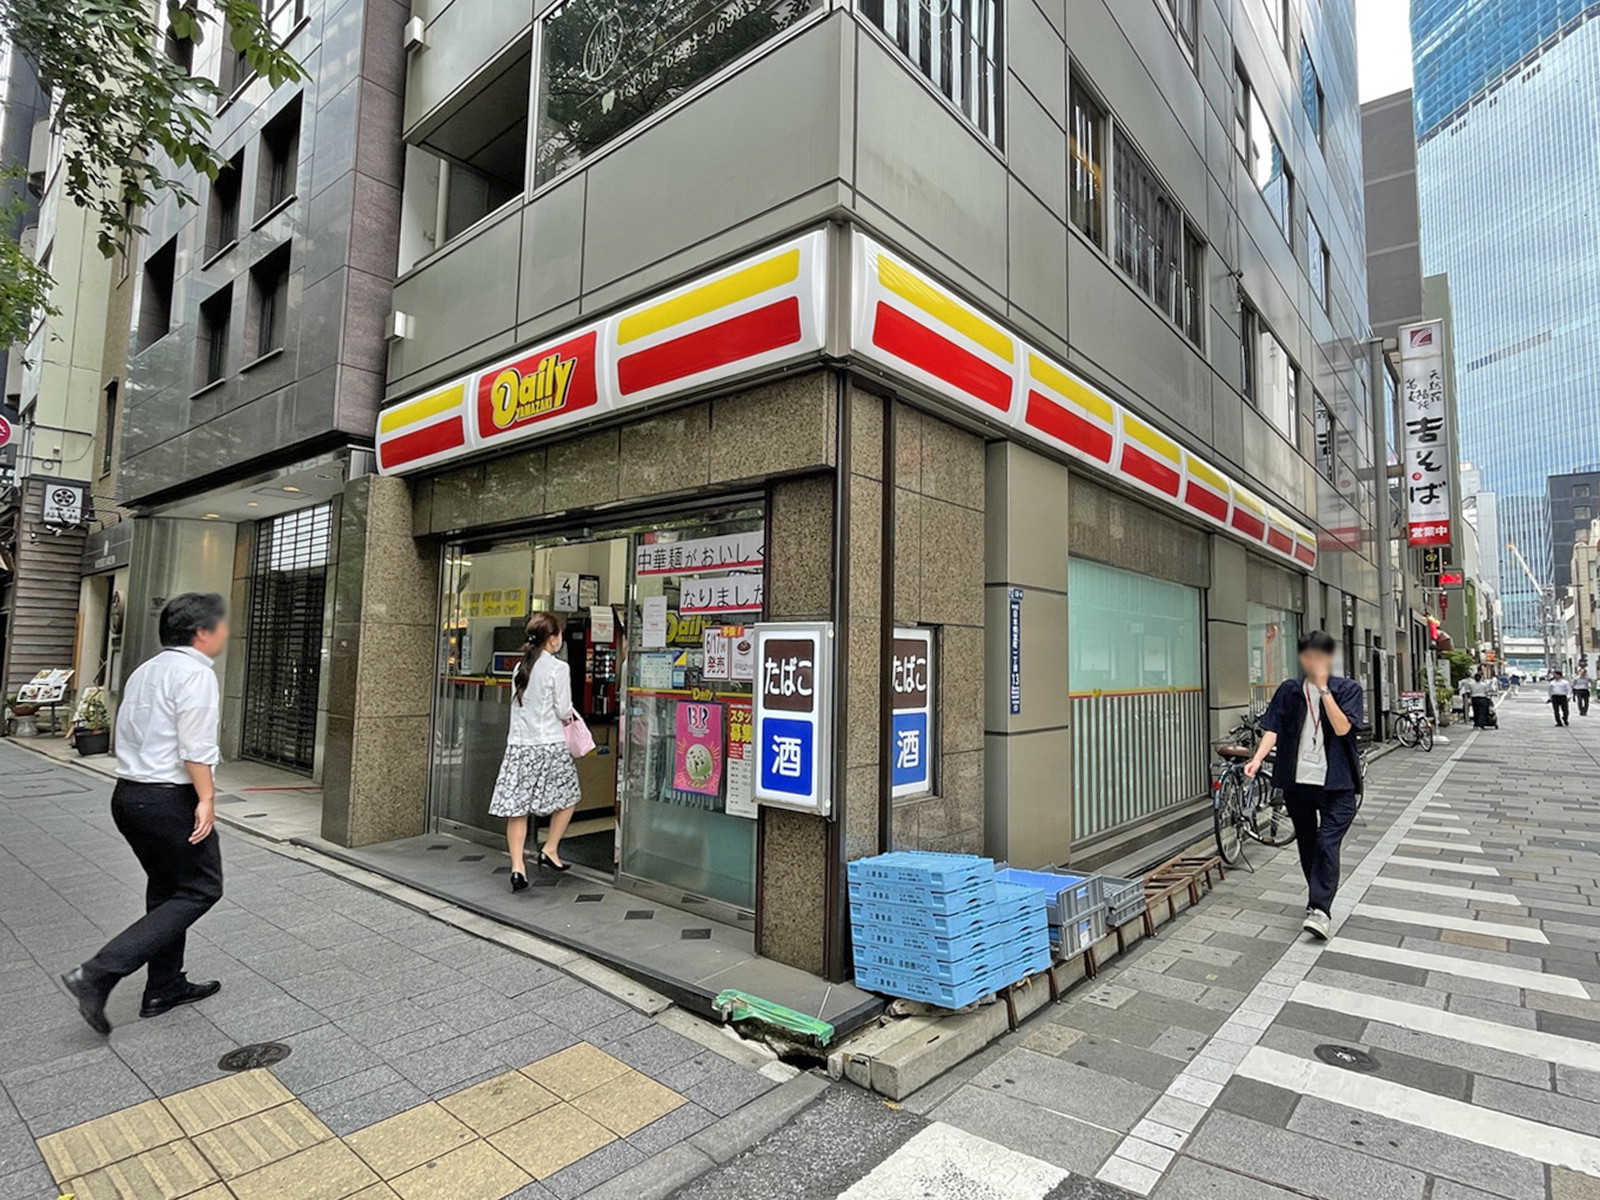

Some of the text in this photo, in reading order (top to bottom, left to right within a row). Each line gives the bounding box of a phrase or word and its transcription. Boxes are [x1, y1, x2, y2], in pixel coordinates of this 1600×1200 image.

[491, 353, 577, 428] Daily
[1406, 416, 1447, 505] 吉そば
[1411, 525, 1448, 538] 営業中
[638, 543, 764, 573] 中華麺がおいしく
[683, 584, 763, 609] なりました
[707, 655, 725, 674] 発売
[765, 656, 813, 697] たばこ
[892, 654, 927, 693] たばこ
[771, 735, 802, 778] 酒
[896, 729, 920, 769] 酒
